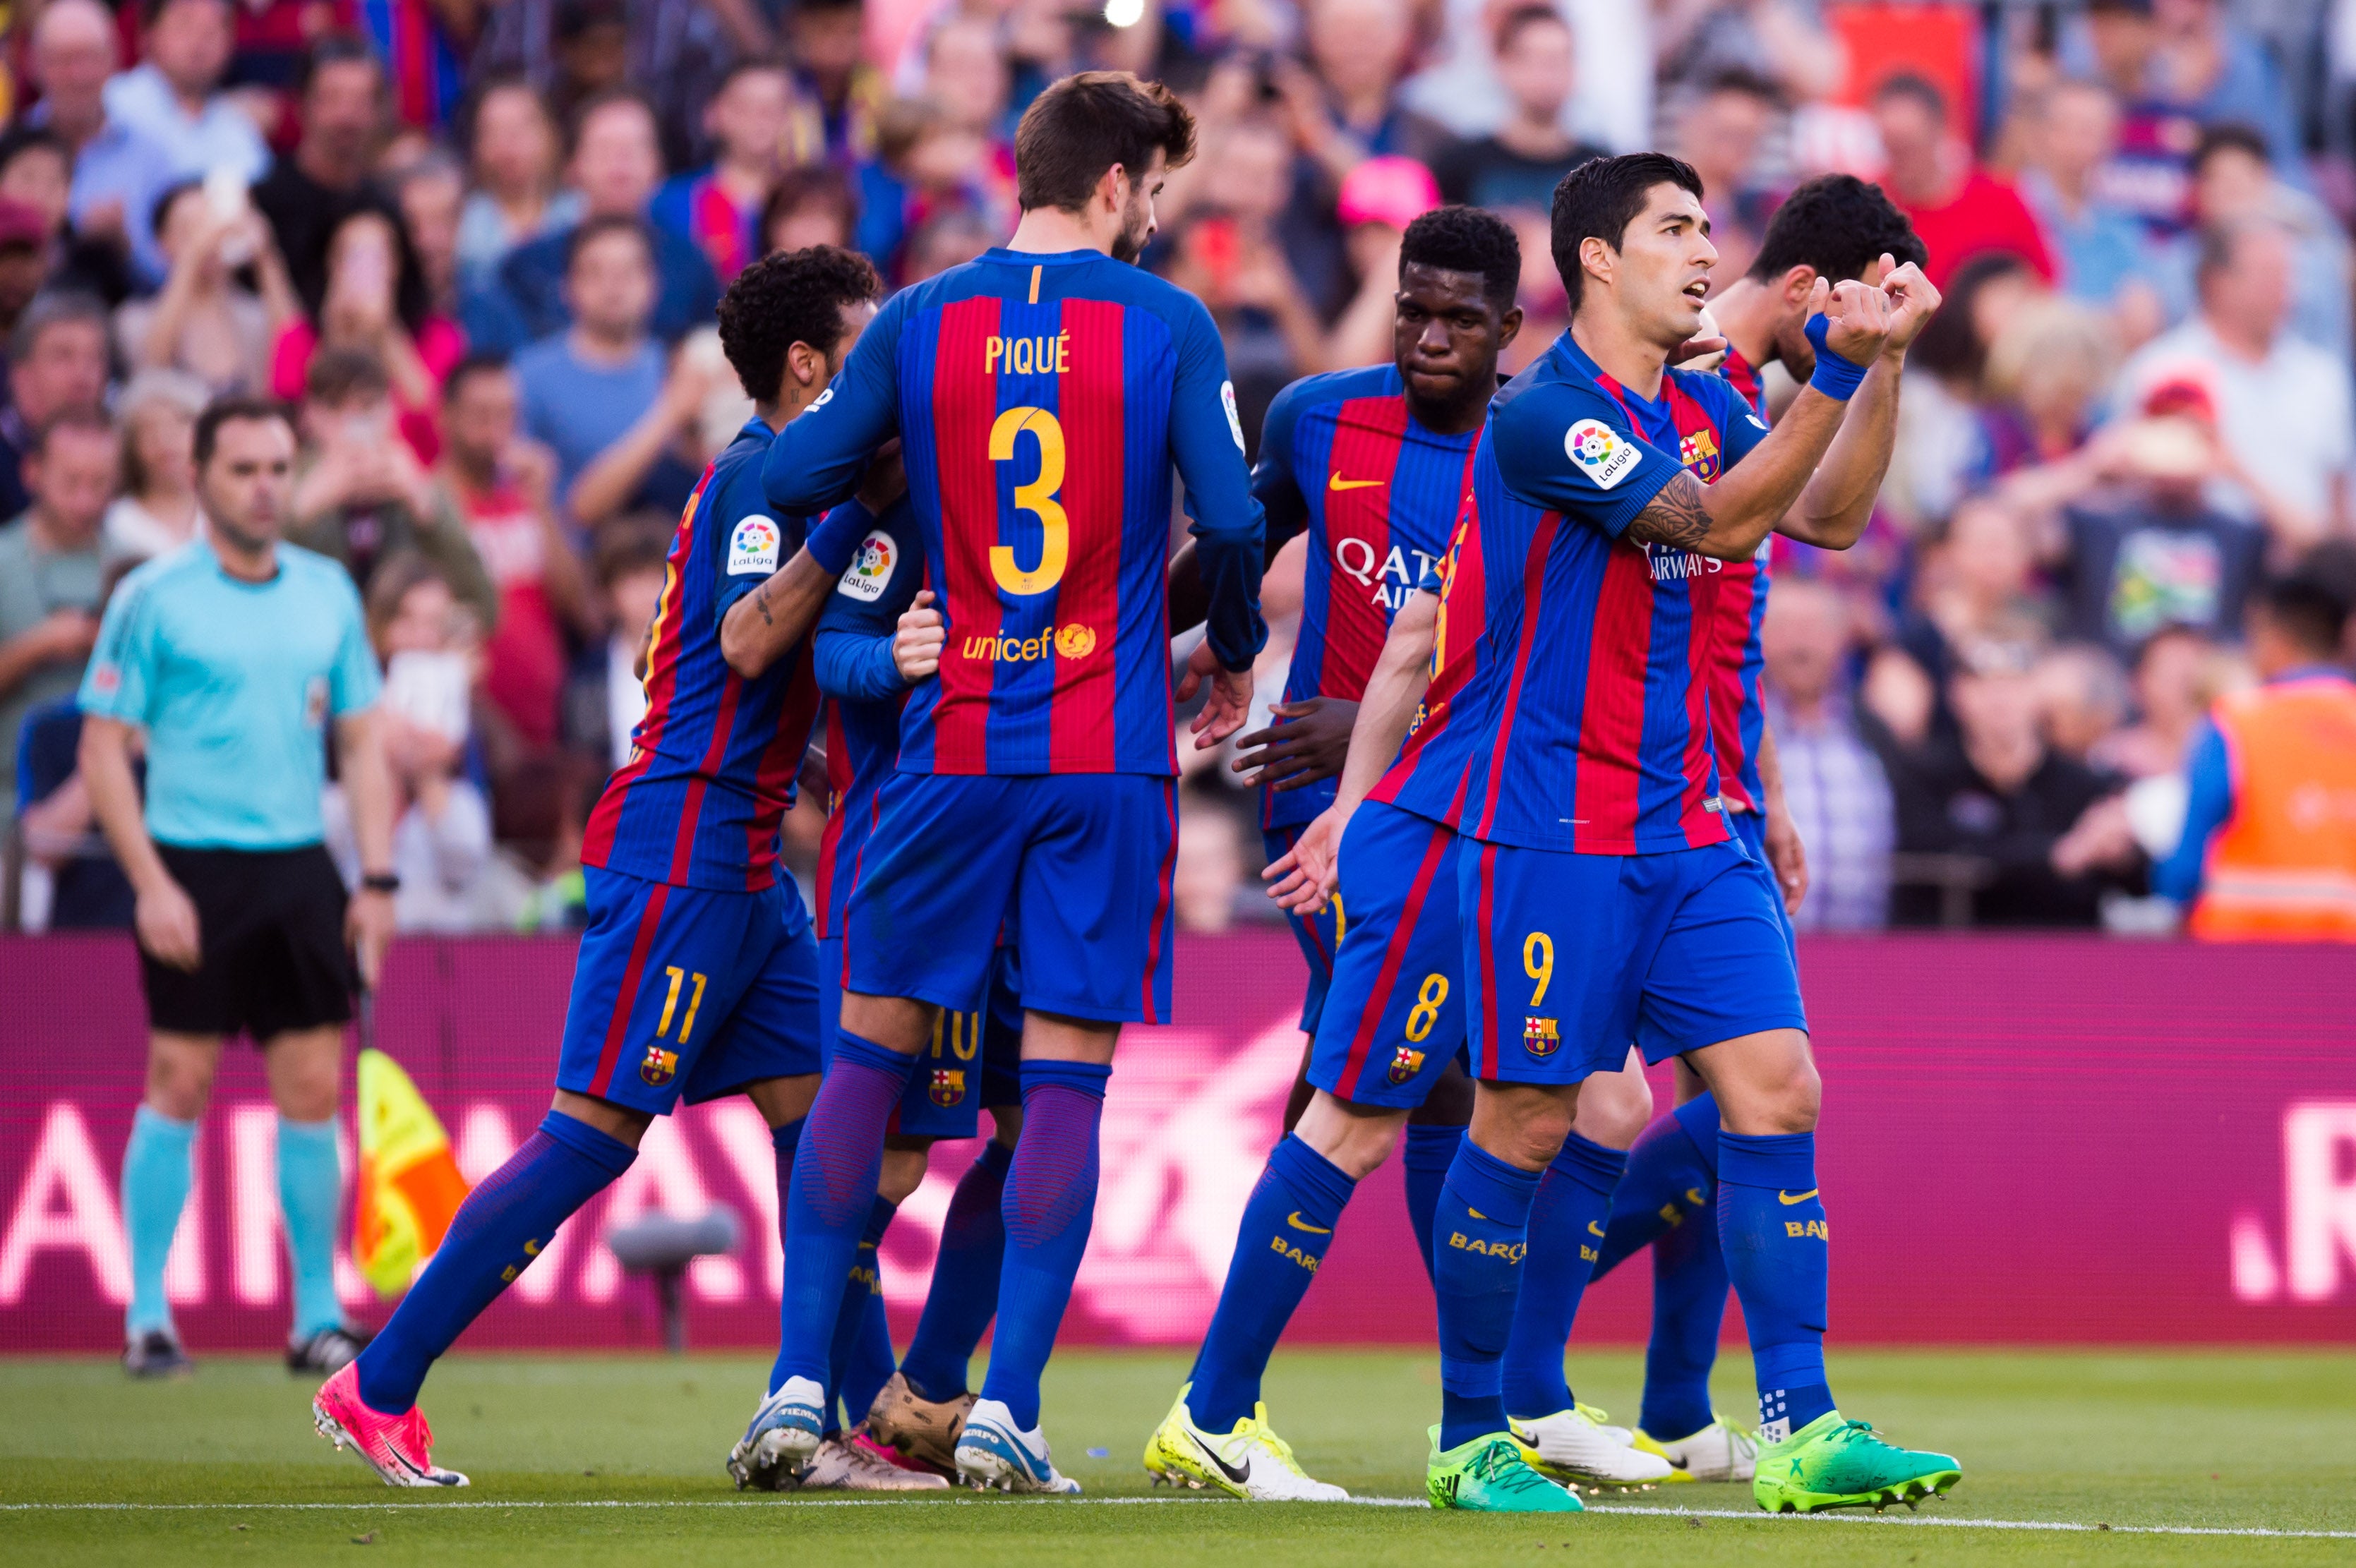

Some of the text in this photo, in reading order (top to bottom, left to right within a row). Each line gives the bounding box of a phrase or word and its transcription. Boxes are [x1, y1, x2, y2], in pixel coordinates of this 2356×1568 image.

[985, 329, 1071, 375] PIQUÉ
[1598, 447, 1632, 482] LaLiga
[988, 406, 1070, 596] 3
[733, 555, 773, 566] LaLiga
[843, 573, 879, 594] LaLiga
[1335, 536, 1439, 587] QAT
[961, 627, 1053, 662] unicef
[1523, 931, 1554, 1007] 9
[656, 965, 707, 1044] 11
[1405, 972, 1449, 1043] 8
[1784, 1220, 1829, 1242] BAR
